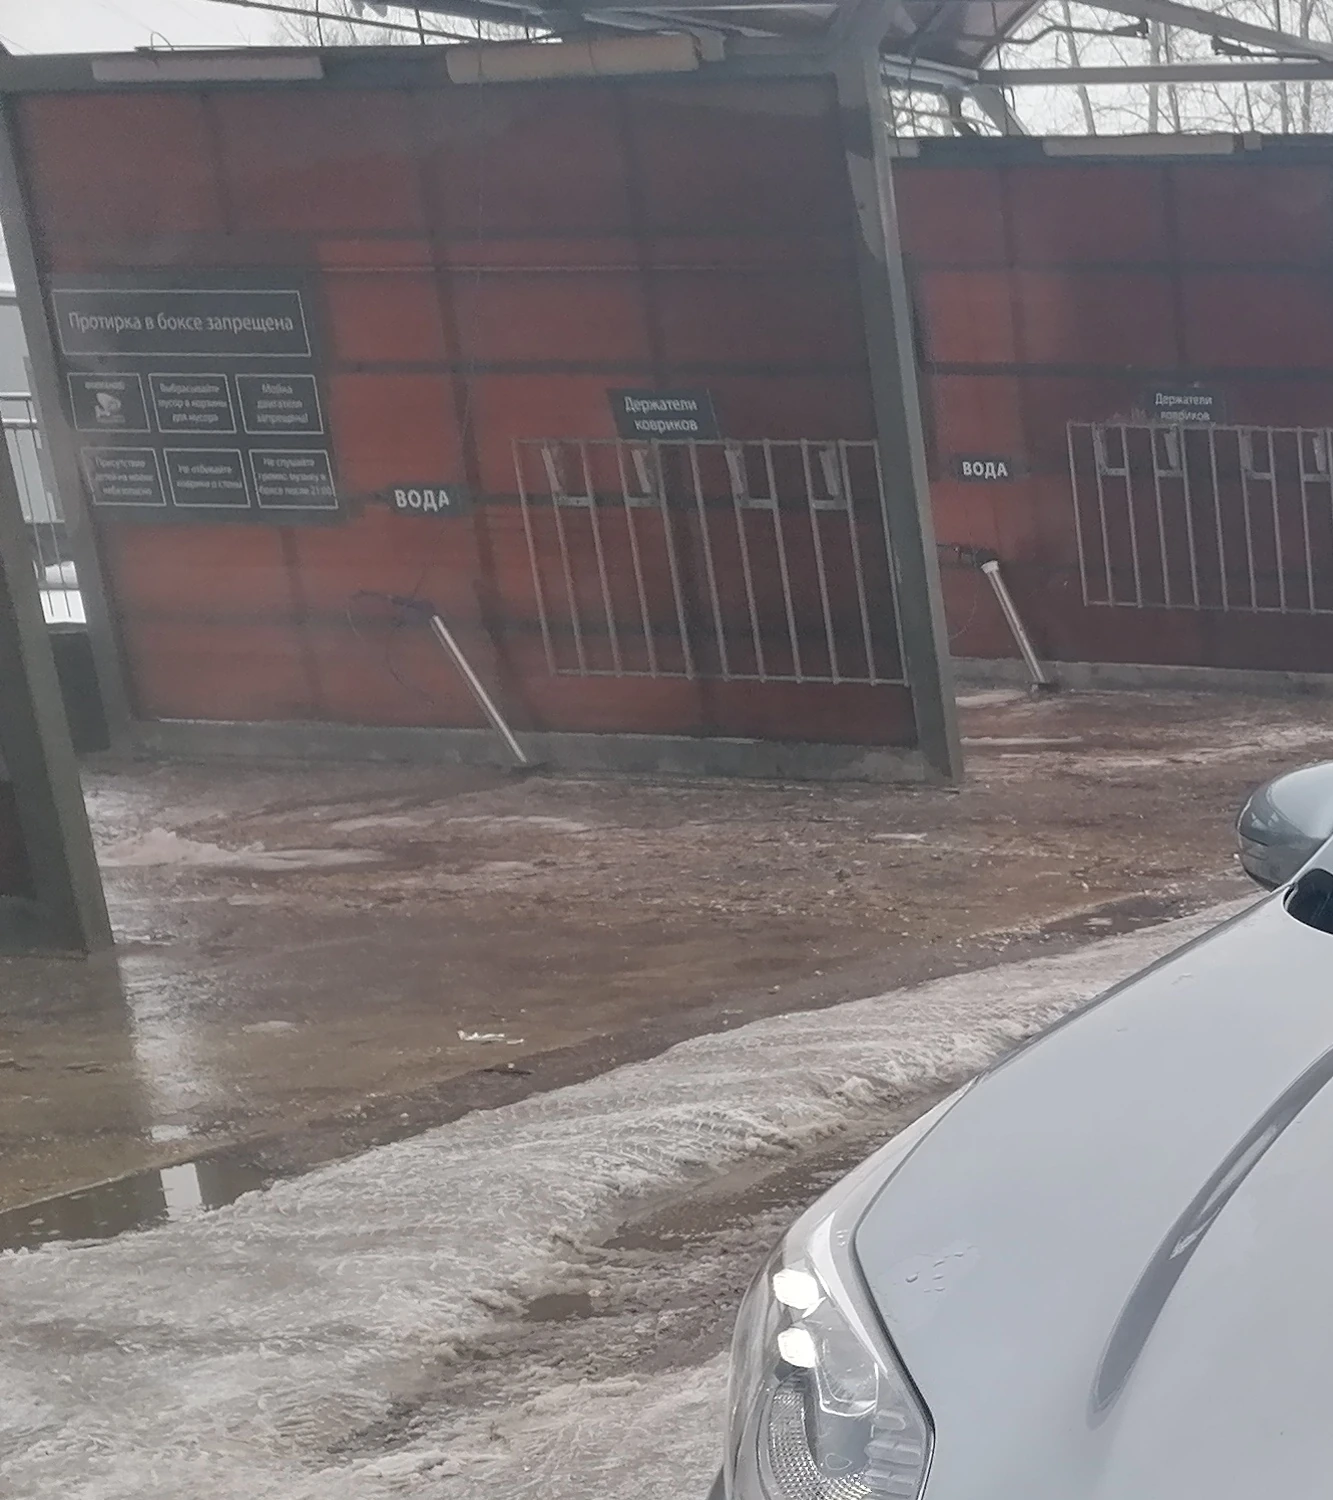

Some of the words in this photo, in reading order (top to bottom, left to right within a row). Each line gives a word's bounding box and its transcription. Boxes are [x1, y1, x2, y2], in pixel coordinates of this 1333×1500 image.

[69, 312, 140, 333] Протирка
[145, 317, 155, 330] в
[157, 312, 203, 331] боксе
[205, 316, 294, 334] запрещена
[624, 396, 698, 414] Держатели
[1155, 392, 1213, 406] Держатели
[634, 419, 698, 434] ковриков
[962, 461, 1008, 480] ВОДА
[394, 489, 449, 512] ВОДА
